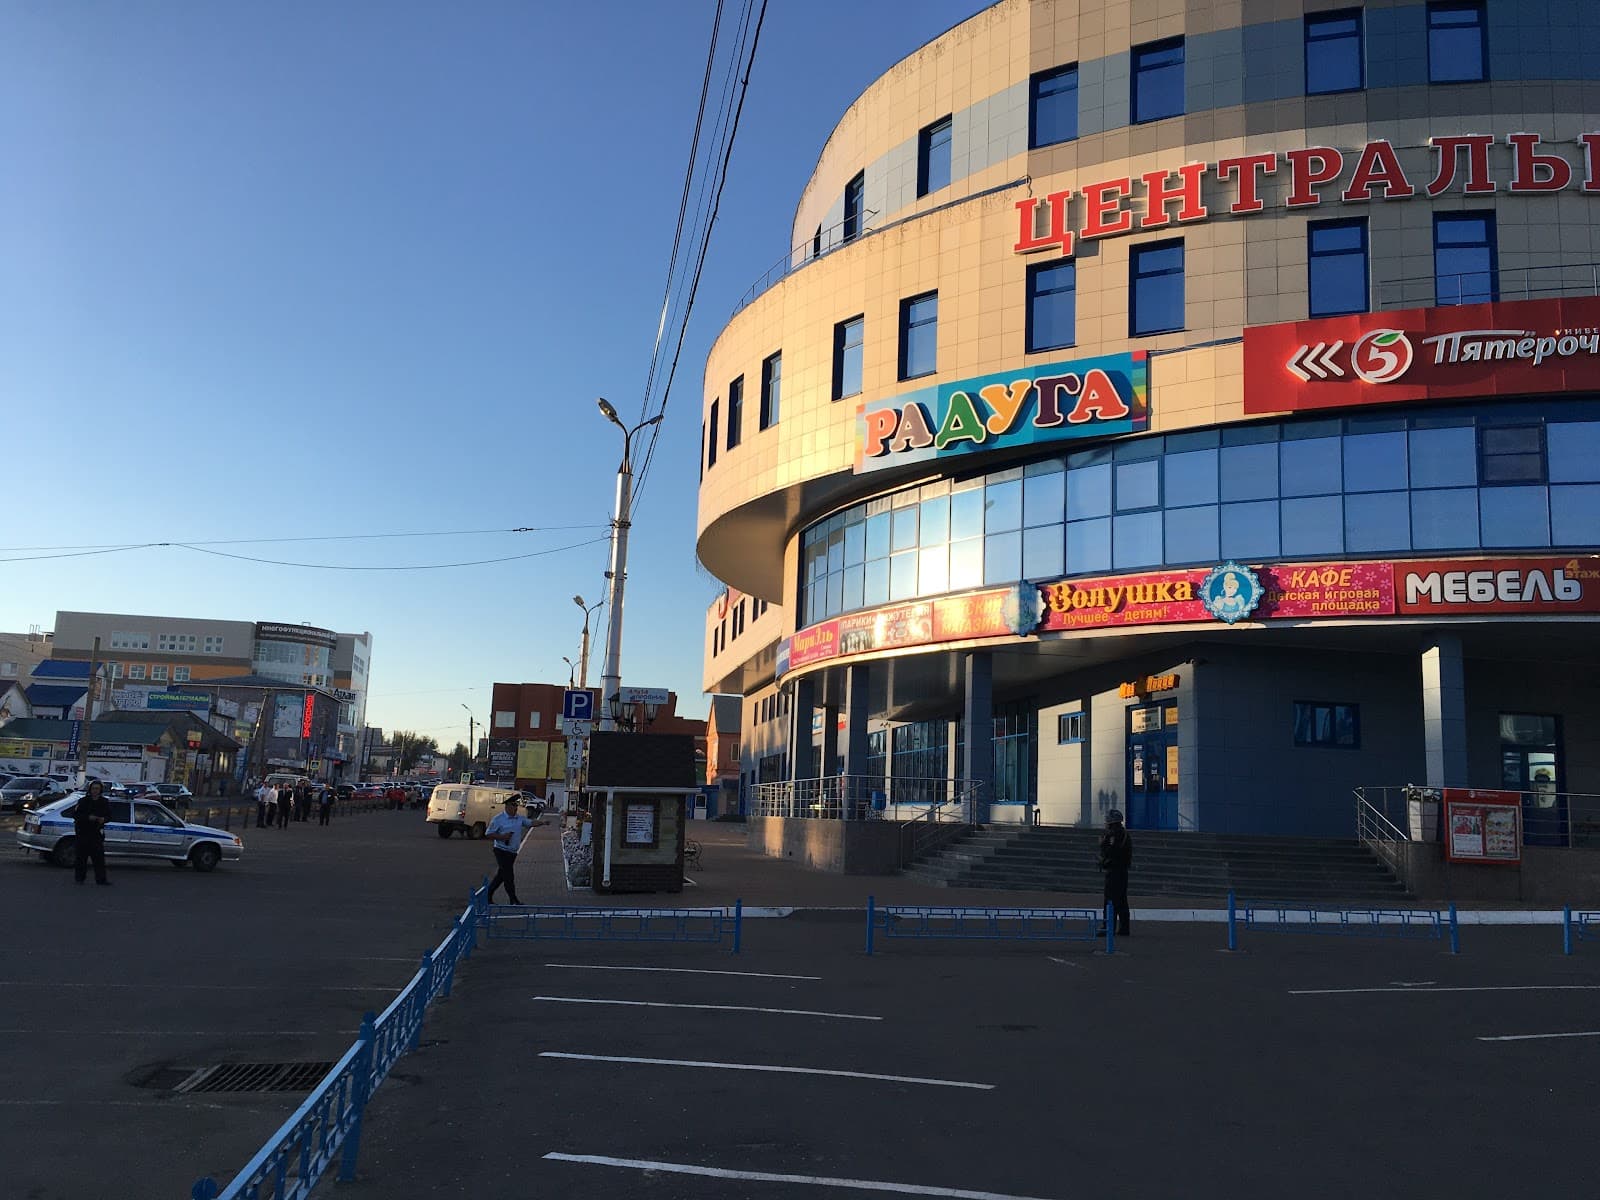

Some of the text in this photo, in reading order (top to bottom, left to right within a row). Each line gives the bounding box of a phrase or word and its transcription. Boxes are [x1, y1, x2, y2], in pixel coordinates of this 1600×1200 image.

[1014, 133, 1600, 256] ЦЕНТРАЛЬ
[864, 368, 1129, 457] РАДУГА
[1290, 568, 1354, 589] КАФЕ
[1405, 567, 1583, 606] МЕБЕЛЬ
[1049, 580, 1193, 613] Золушка
[1311, 600, 1380, 612] площадка
[1325, 589, 1380, 600] игровая
[1063, 612, 1109, 625] Лучшее
[1124, 607, 1168, 621] детям!
